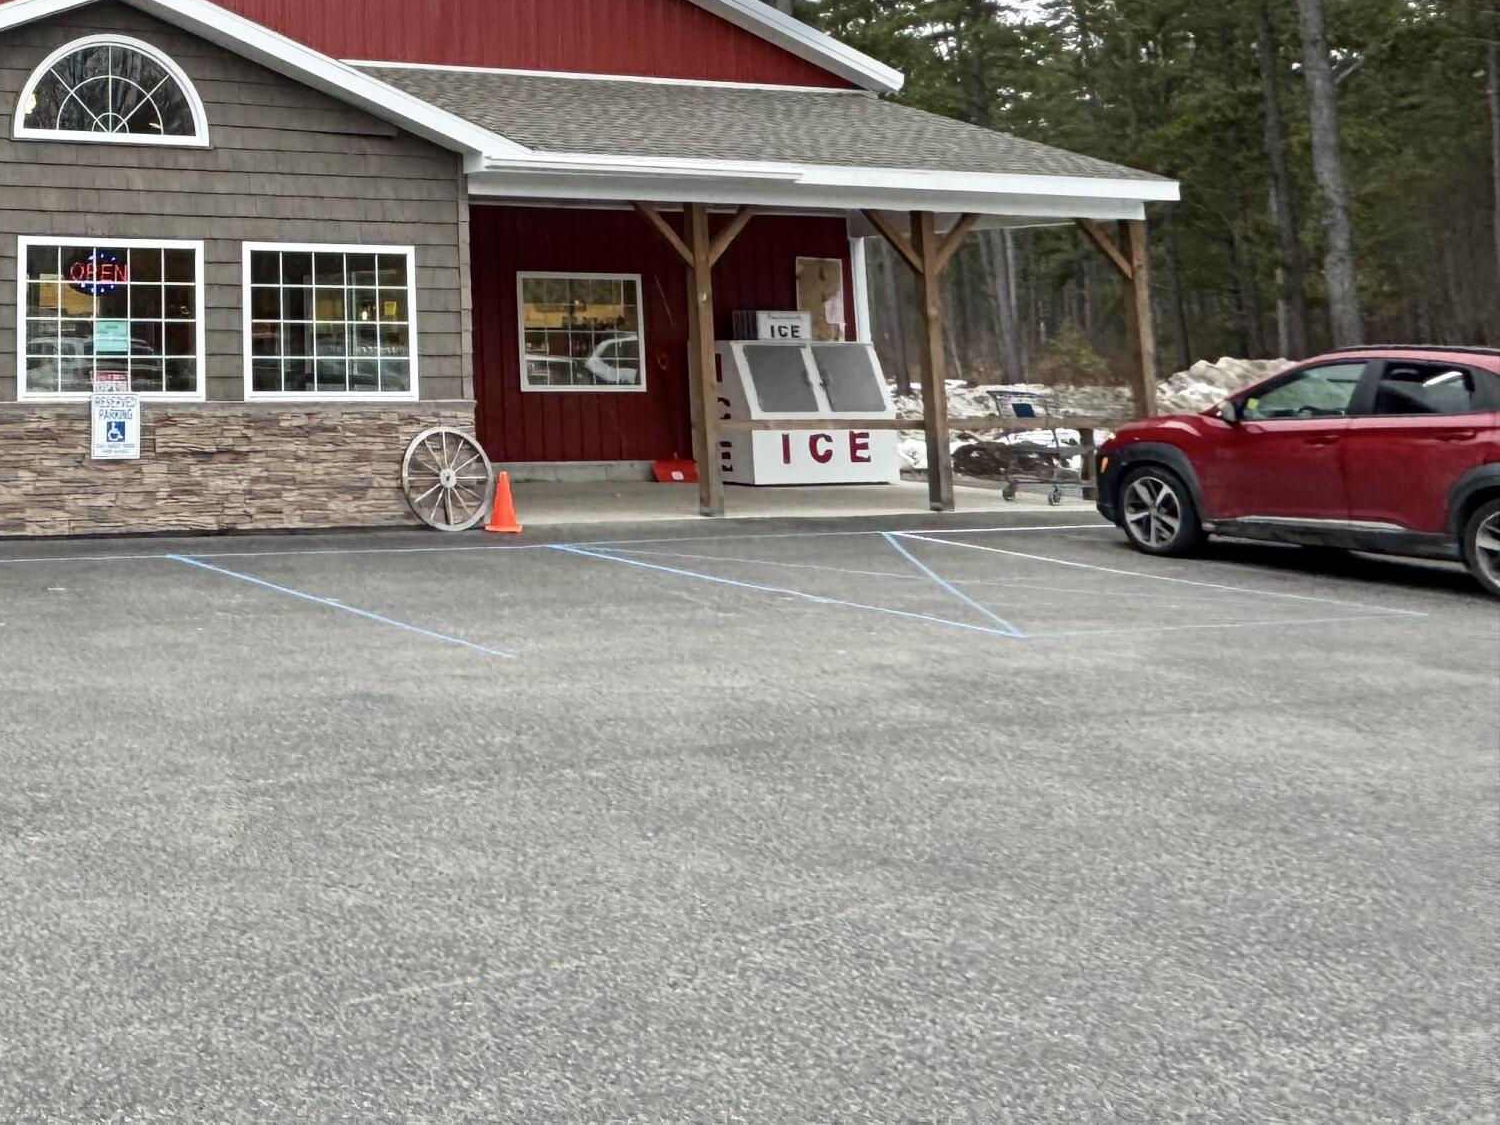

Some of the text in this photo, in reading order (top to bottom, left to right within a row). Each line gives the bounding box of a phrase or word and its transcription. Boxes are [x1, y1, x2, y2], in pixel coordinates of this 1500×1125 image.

[70, 262, 128, 282] OPEN
[770, 325, 801, 338] ICE
[95, 396, 138, 408] RESERVED
[99, 408, 132, 420] PARKING
[781, 431, 872, 465] ICE
